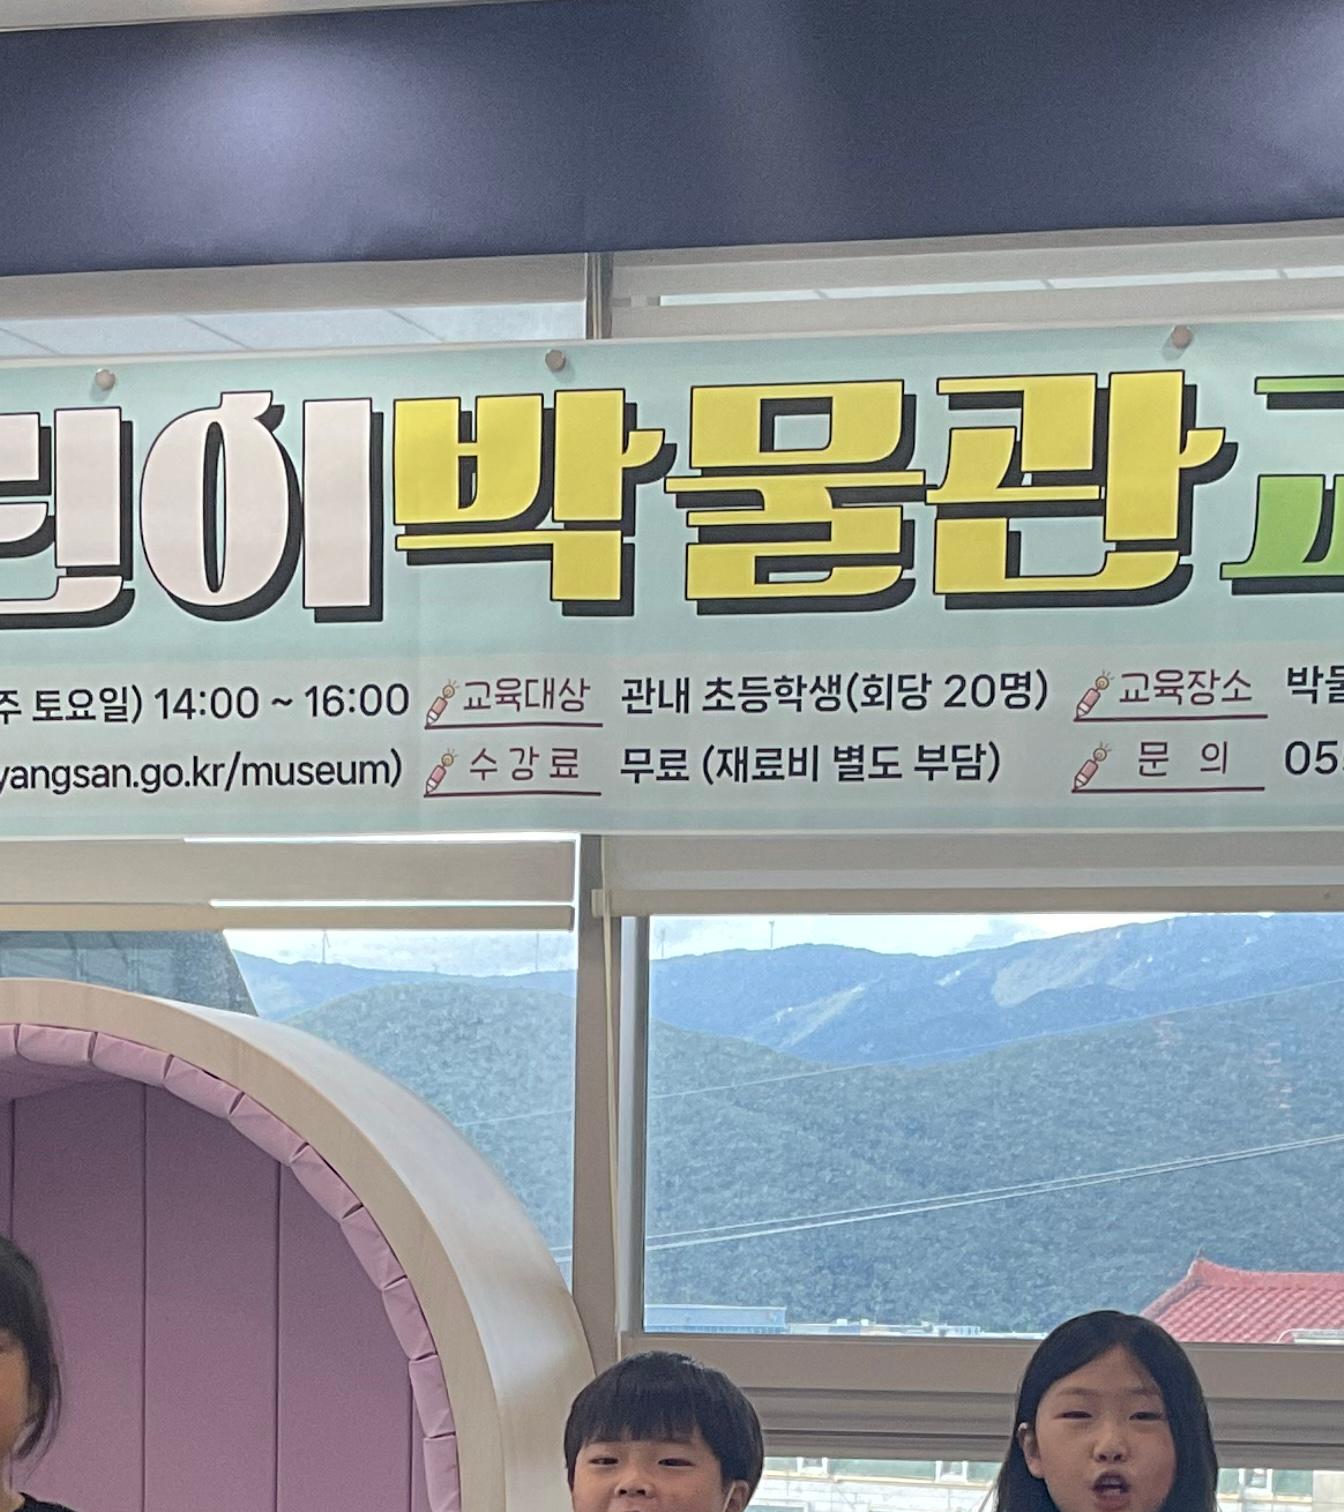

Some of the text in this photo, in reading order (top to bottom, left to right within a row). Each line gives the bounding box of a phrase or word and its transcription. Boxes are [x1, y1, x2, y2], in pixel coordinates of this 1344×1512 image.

[32, 684, 142, 724] 토요일)
[154, 686, 259, 720] 14:00
[304, 683, 409, 717] 16:00
[463, 668, 1048, 715] 교육대상 관내 초등학생(회당 20명)
[1119, 669, 1252, 706] 교육장소
[620, 748, 690, 785] 무료
[702, 744, 819, 786] (재료비
[833, 744, 903, 782] 별도
[913, 741, 1000, 783] 부담)
